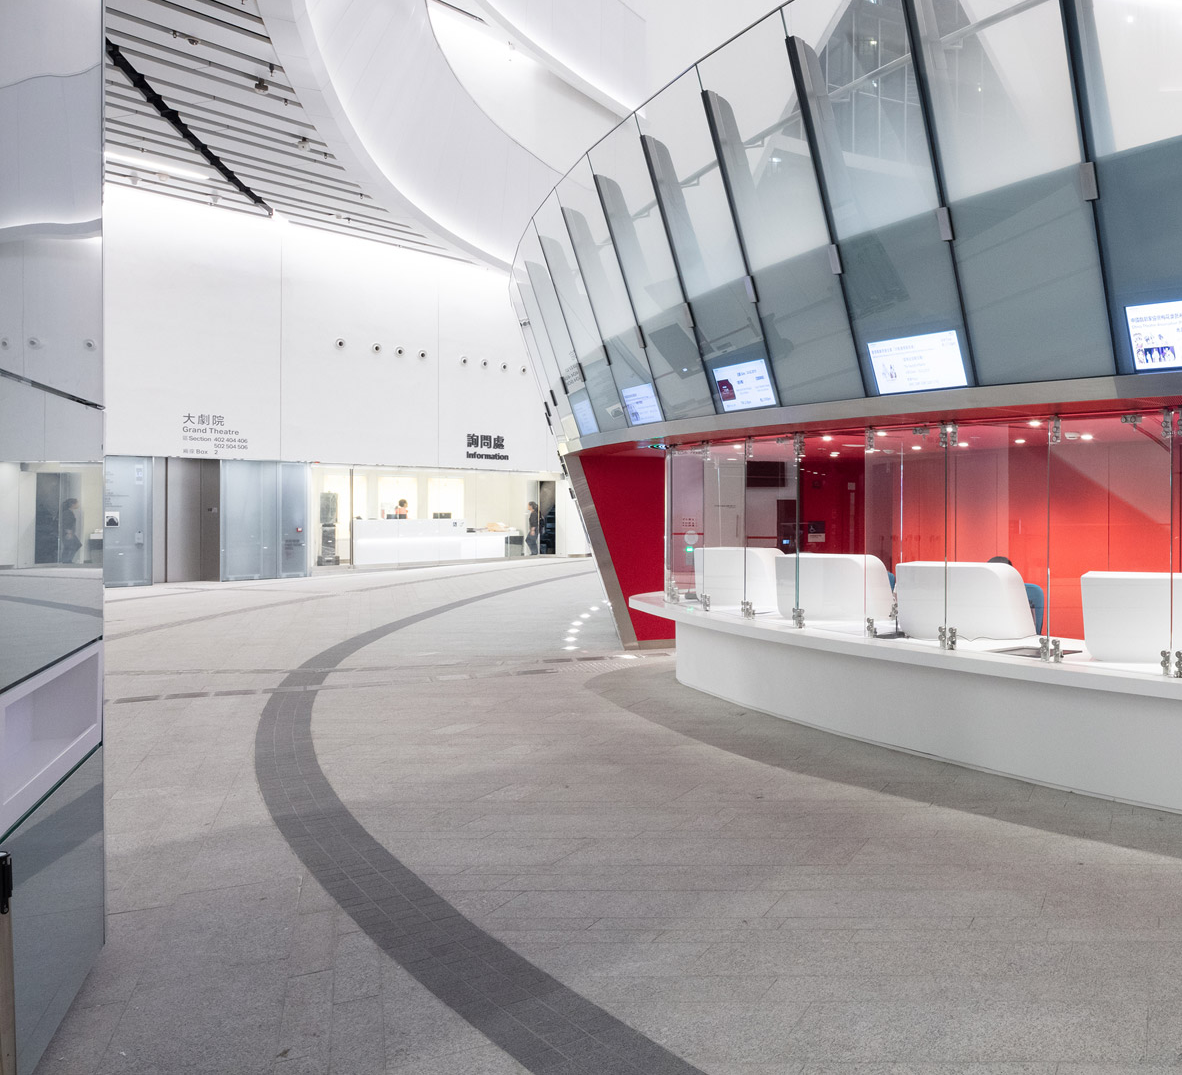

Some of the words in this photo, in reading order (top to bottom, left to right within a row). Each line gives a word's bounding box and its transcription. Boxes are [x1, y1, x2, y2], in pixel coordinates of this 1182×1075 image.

[183, 413, 225, 426] 大劇院
[182, 426, 207, 434] Grand
[209, 427, 240, 436] Theatre
[467, 433, 504, 449] 詢問處
[466, 451, 509, 460] Information
